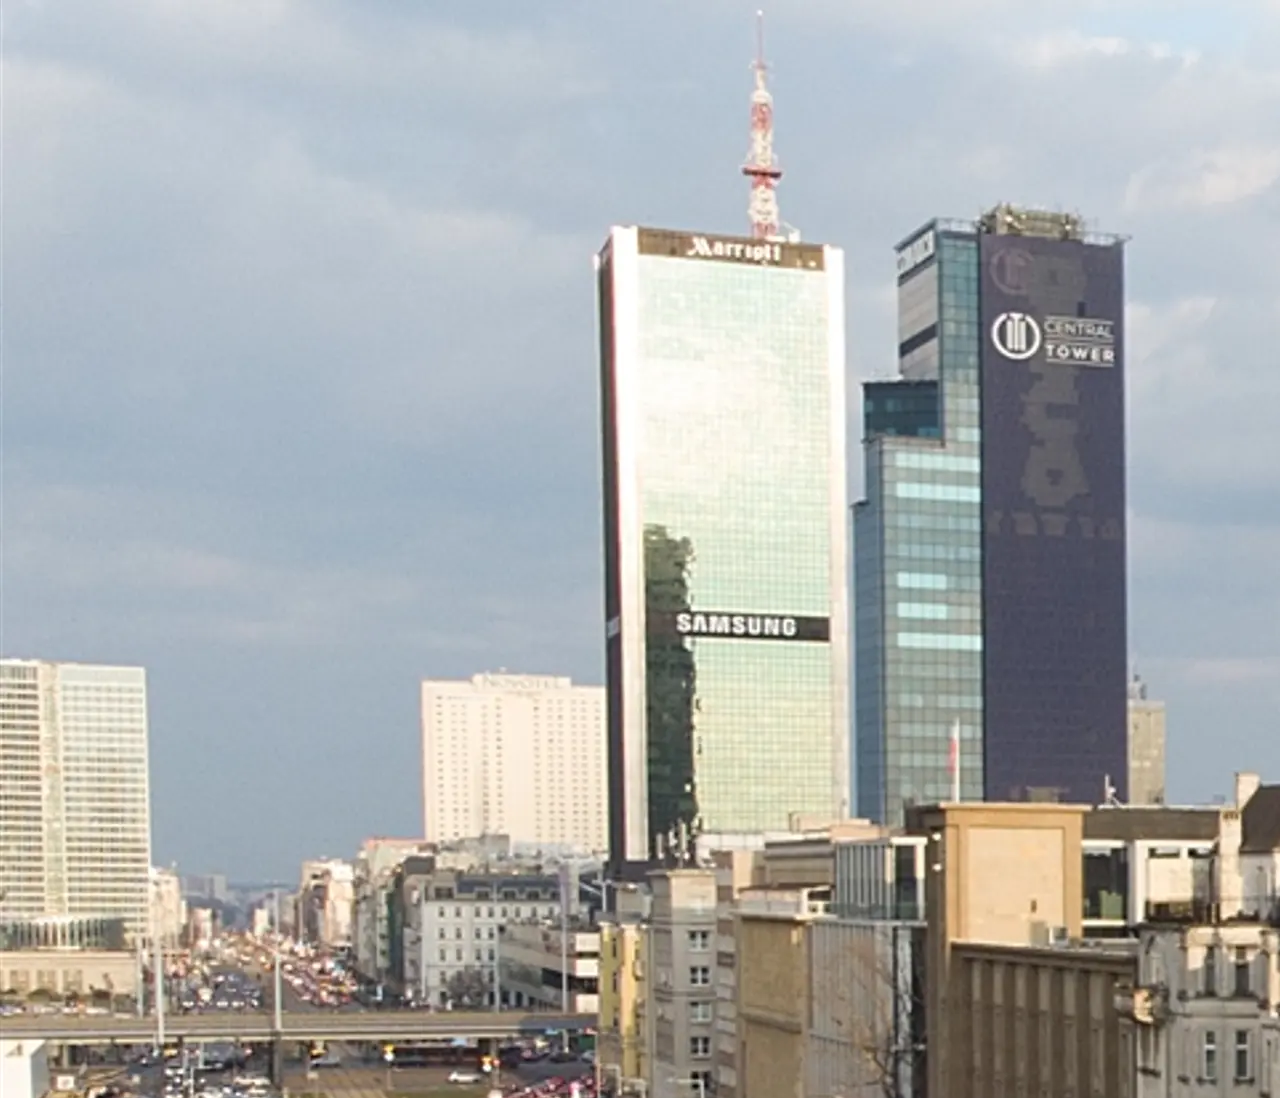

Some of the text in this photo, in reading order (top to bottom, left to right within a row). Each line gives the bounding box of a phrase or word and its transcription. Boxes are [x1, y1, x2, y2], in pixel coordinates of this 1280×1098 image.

[1045, 321, 1112, 337] CENTRAL
[1046, 345, 1114, 362] TOWER
[676, 613, 797, 636] SAMSUNG
